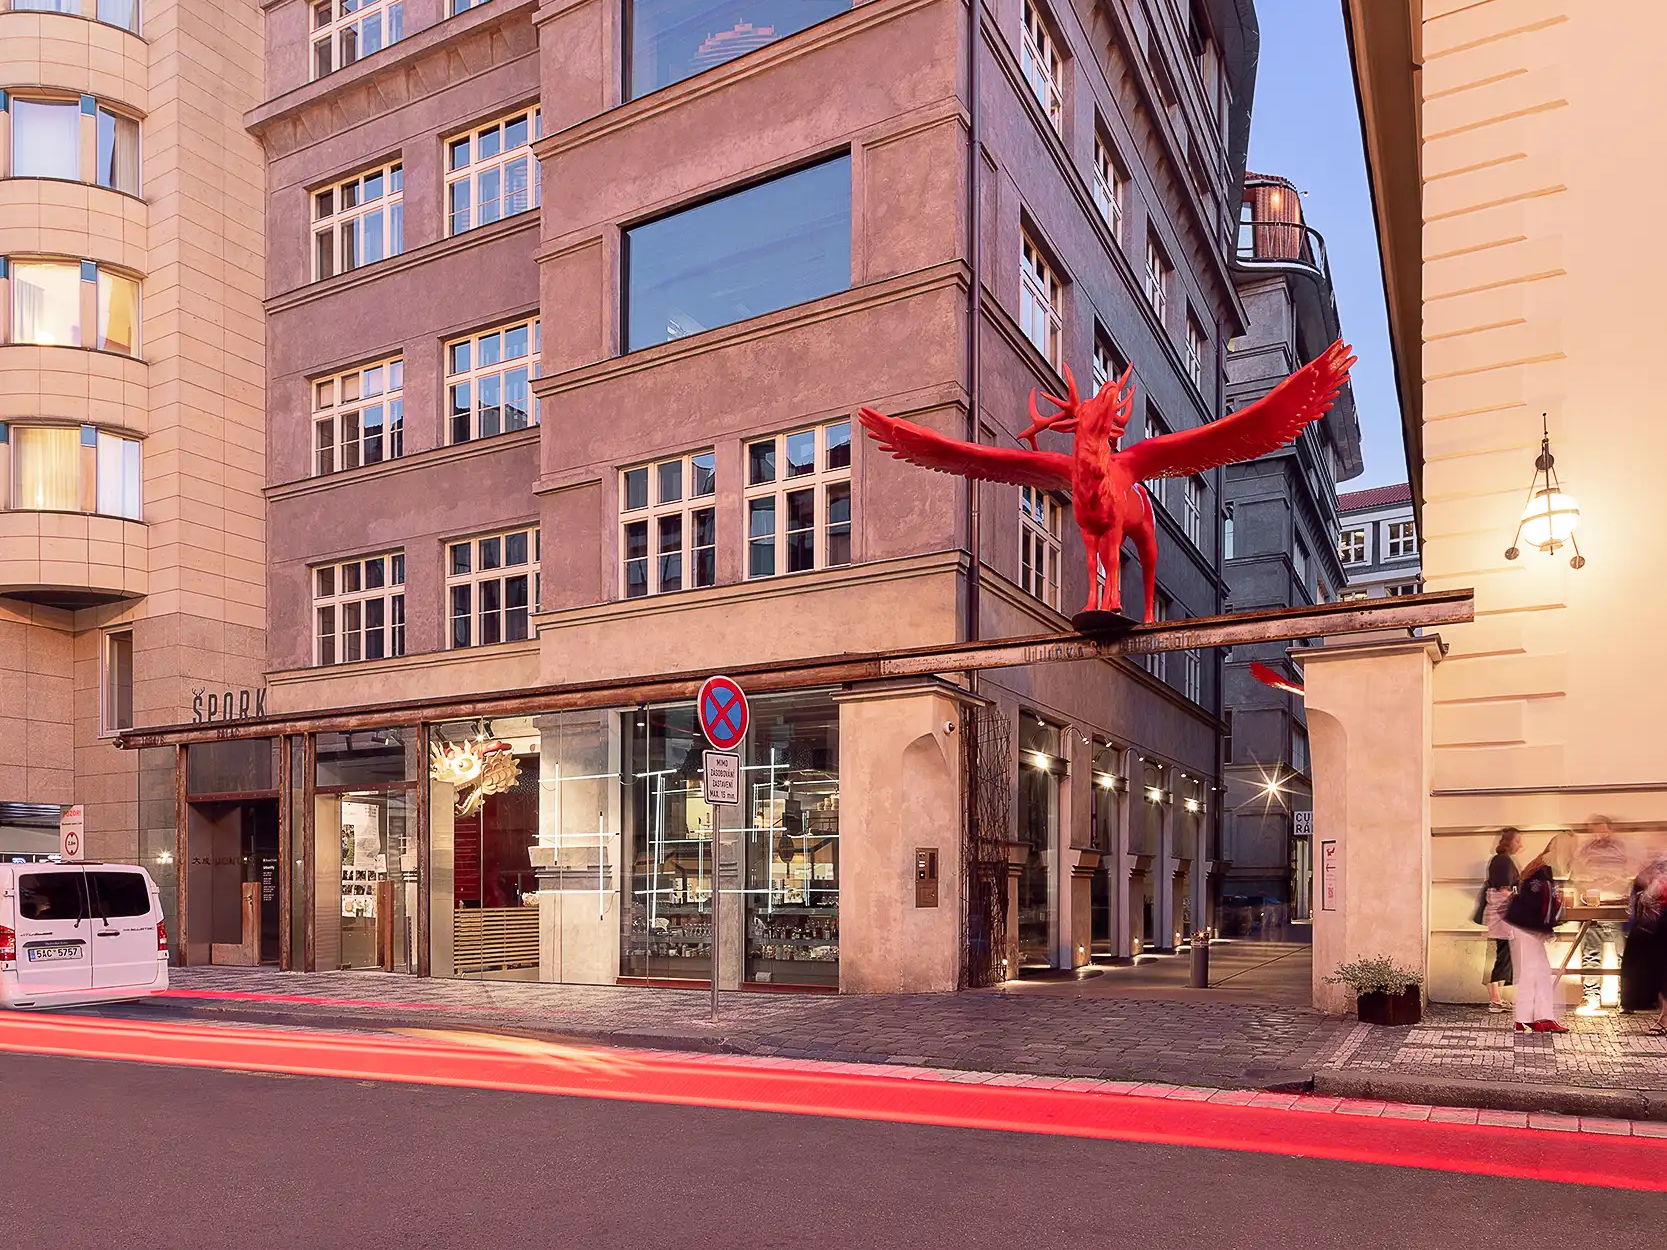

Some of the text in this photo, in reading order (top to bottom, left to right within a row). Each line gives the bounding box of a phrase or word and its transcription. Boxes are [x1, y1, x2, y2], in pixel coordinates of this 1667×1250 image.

[716, 759, 728, 767] MIMO
[36, 947, 78, 959] 5AC 5757
